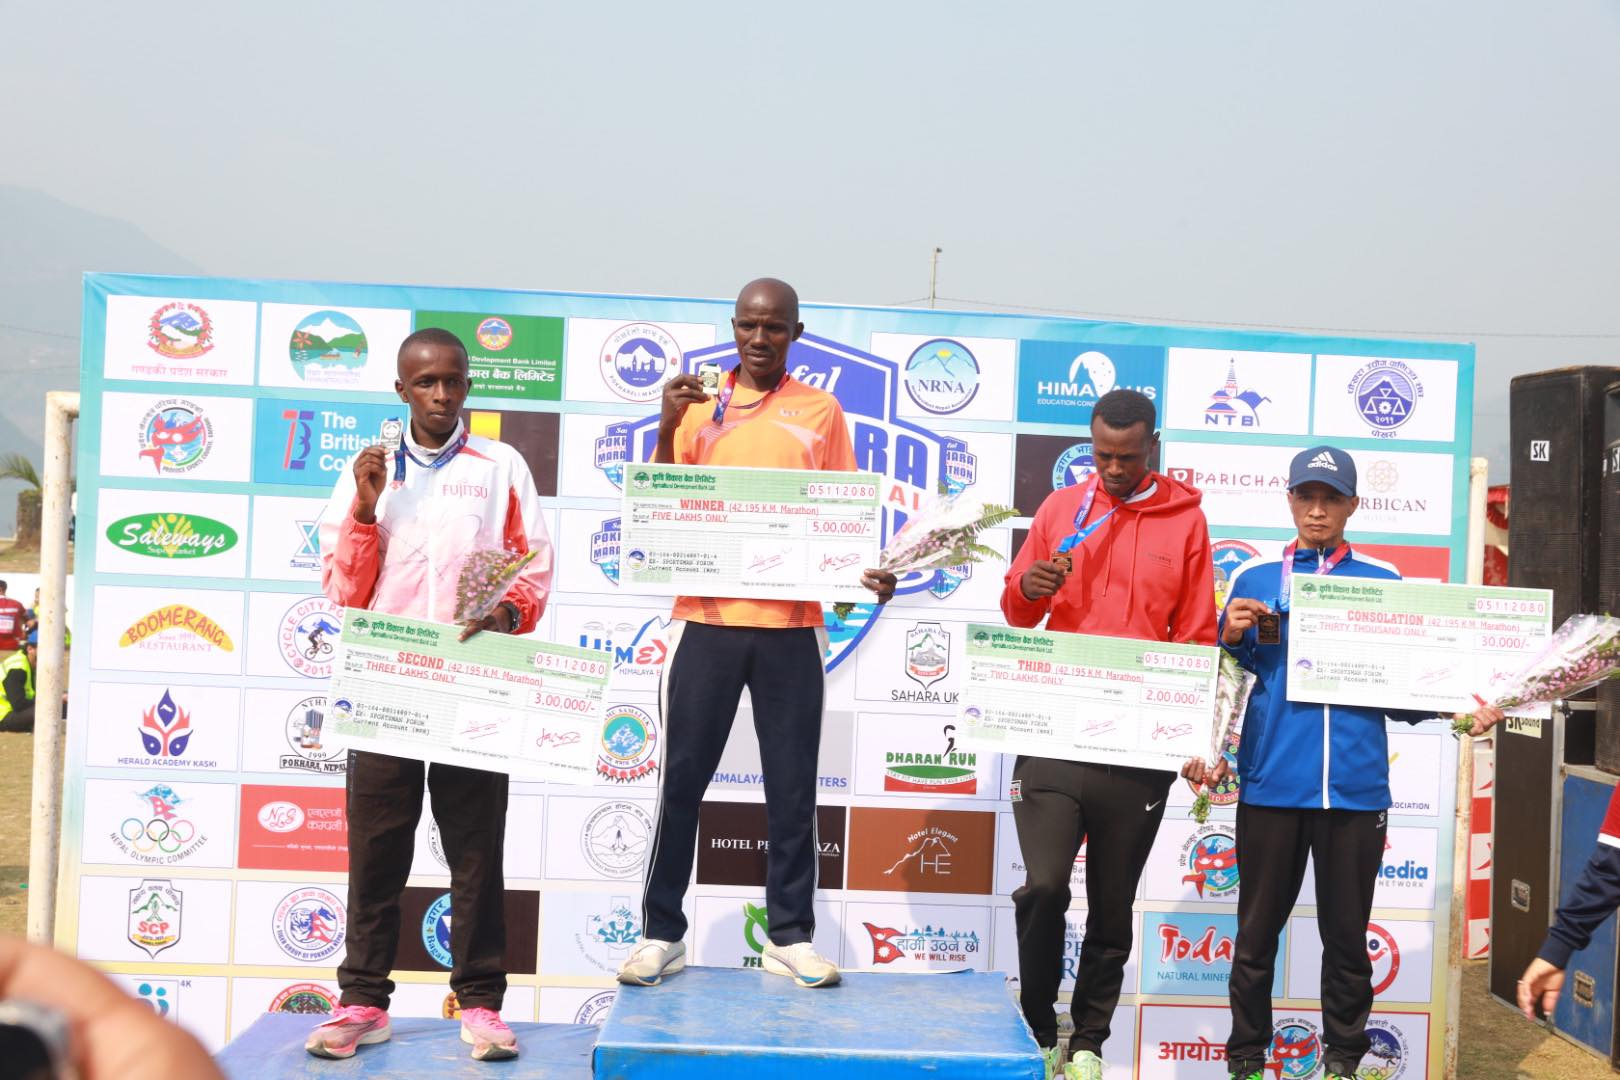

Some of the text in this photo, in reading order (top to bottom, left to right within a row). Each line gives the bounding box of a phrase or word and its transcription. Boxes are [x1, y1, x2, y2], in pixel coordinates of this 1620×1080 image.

[918, 378, 965, 393] NRNA
[321, 411, 357, 429] The
[1205, 413, 1254, 427] NTB
[1533, 441, 1547, 459] SK
[1307, 460, 1338, 471] adidas
[442, 484, 488, 499] FUJITSU
[680, 499, 724, 511] WINNER
[652, 511, 671, 521] FIVE
[674, 512, 703, 522] LAKHS
[118, 522, 226, 554] Saleways
[1347, 610, 1424, 626] CONSOLATION
[127, 606, 225, 647] BOOMERANG
[282, 615, 298, 659] CYCLE
[297, 601, 324, 616] CITY
[1319, 621, 1349, 633] THIRTY
[1353, 623, 1401, 636] THOUSAND
[139, 641, 212, 652] RESTAURANT
[397, 651, 444, 670] SECOND
[1018, 659, 1051, 673] THIRD
[304, 664, 332, 676] 2012
[367, 660, 396, 674] THREE
[399, 666, 430, 681] LAKHS
[990, 670, 1009, 680] TWO
[1010, 672, 1039, 684] LAKHS
[891, 689, 959, 704] SAHARA UK
[152, 759, 191, 767] ACADEMY
[193, 760, 217, 768] KASKI
[886, 752, 976, 766] DHARAN RUN
[907, 827, 959, 844] Hotel Elegant
[110, 832, 208, 865] NEPAL OLYMPIC COMMITTEE
[711, 838, 753, 849] HOTEL
[138, 921, 169, 935] SCP
[914, 953, 966, 962] WE WILL RISE
[1157, 971, 1199, 981] NATURAL
[180, 979, 192, 988] 4K
